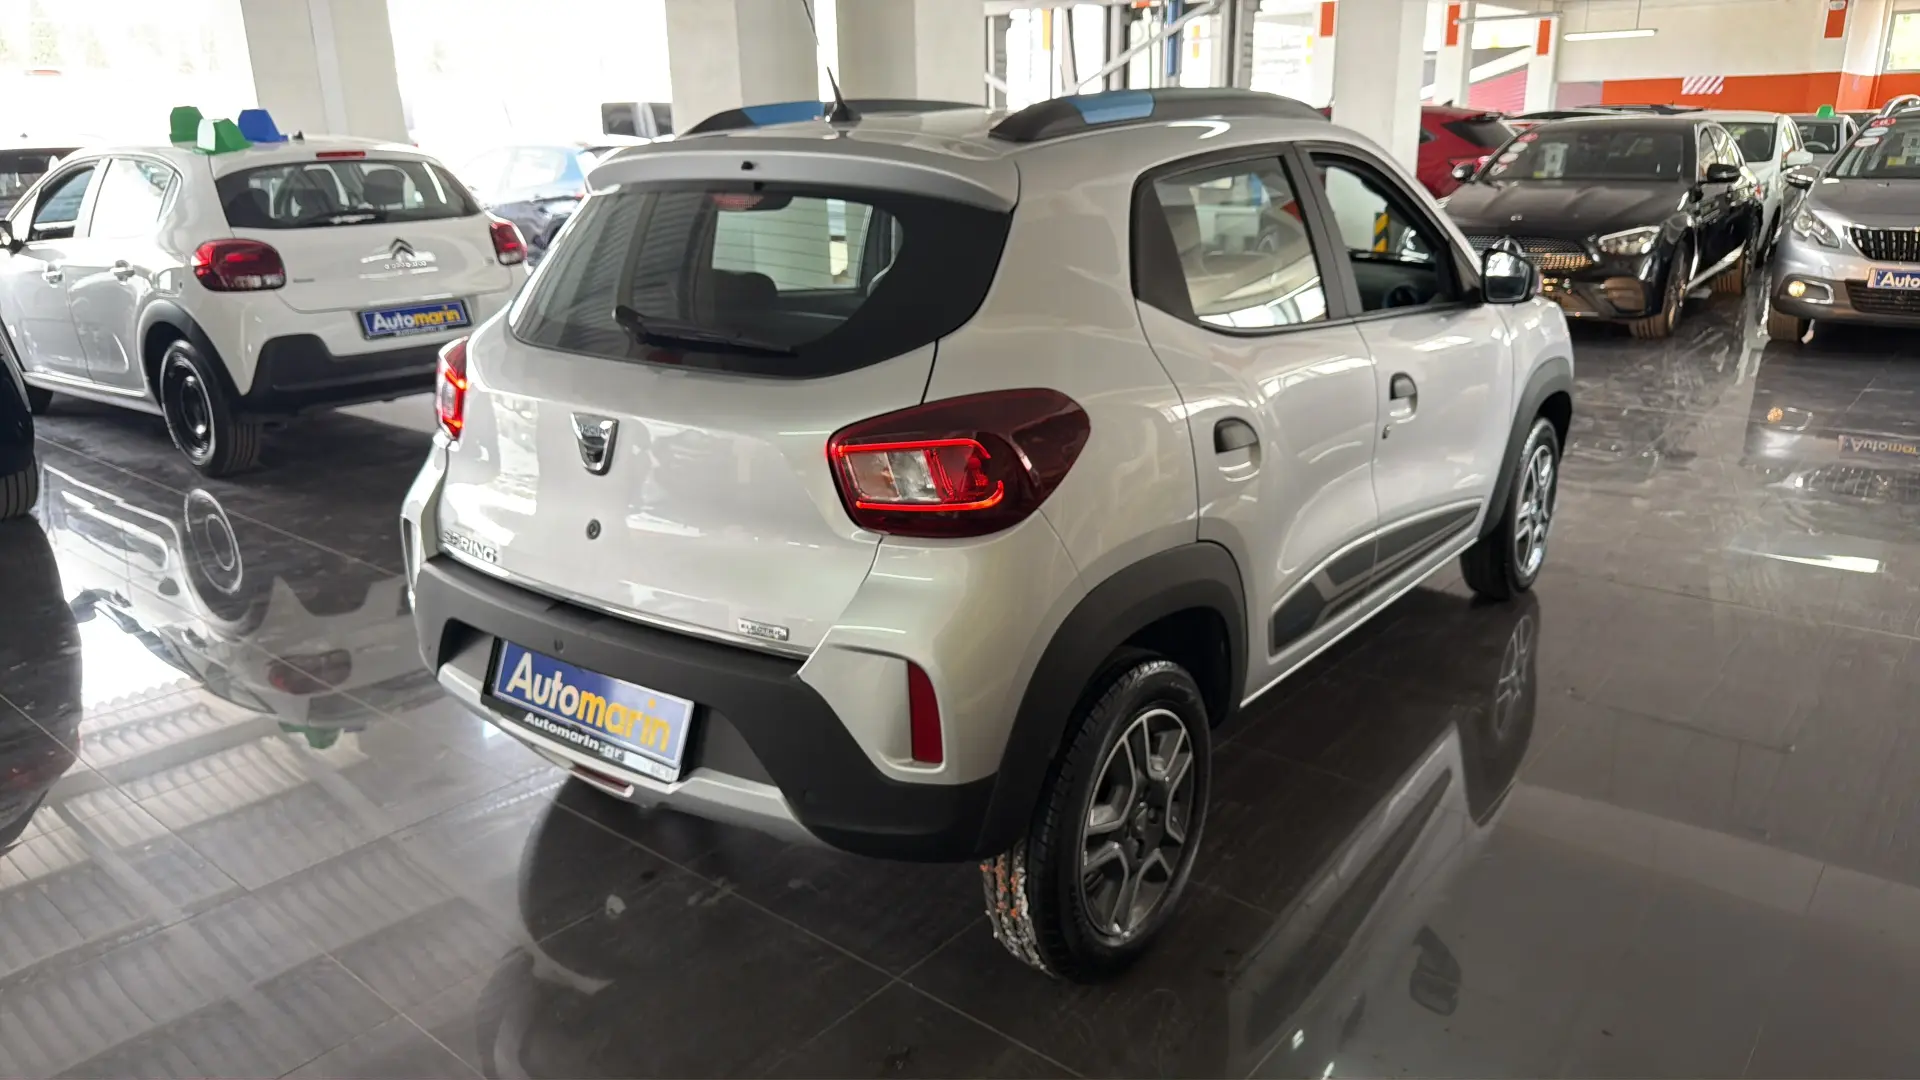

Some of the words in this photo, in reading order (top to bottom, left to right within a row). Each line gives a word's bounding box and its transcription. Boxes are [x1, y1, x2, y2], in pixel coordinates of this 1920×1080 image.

[1880, 272, 1920, 288] Auto
[373, 304, 461, 332] Automarin
[506, 652, 671, 752] Automarin
[524, 712, 623, 762] Automarin.gr
